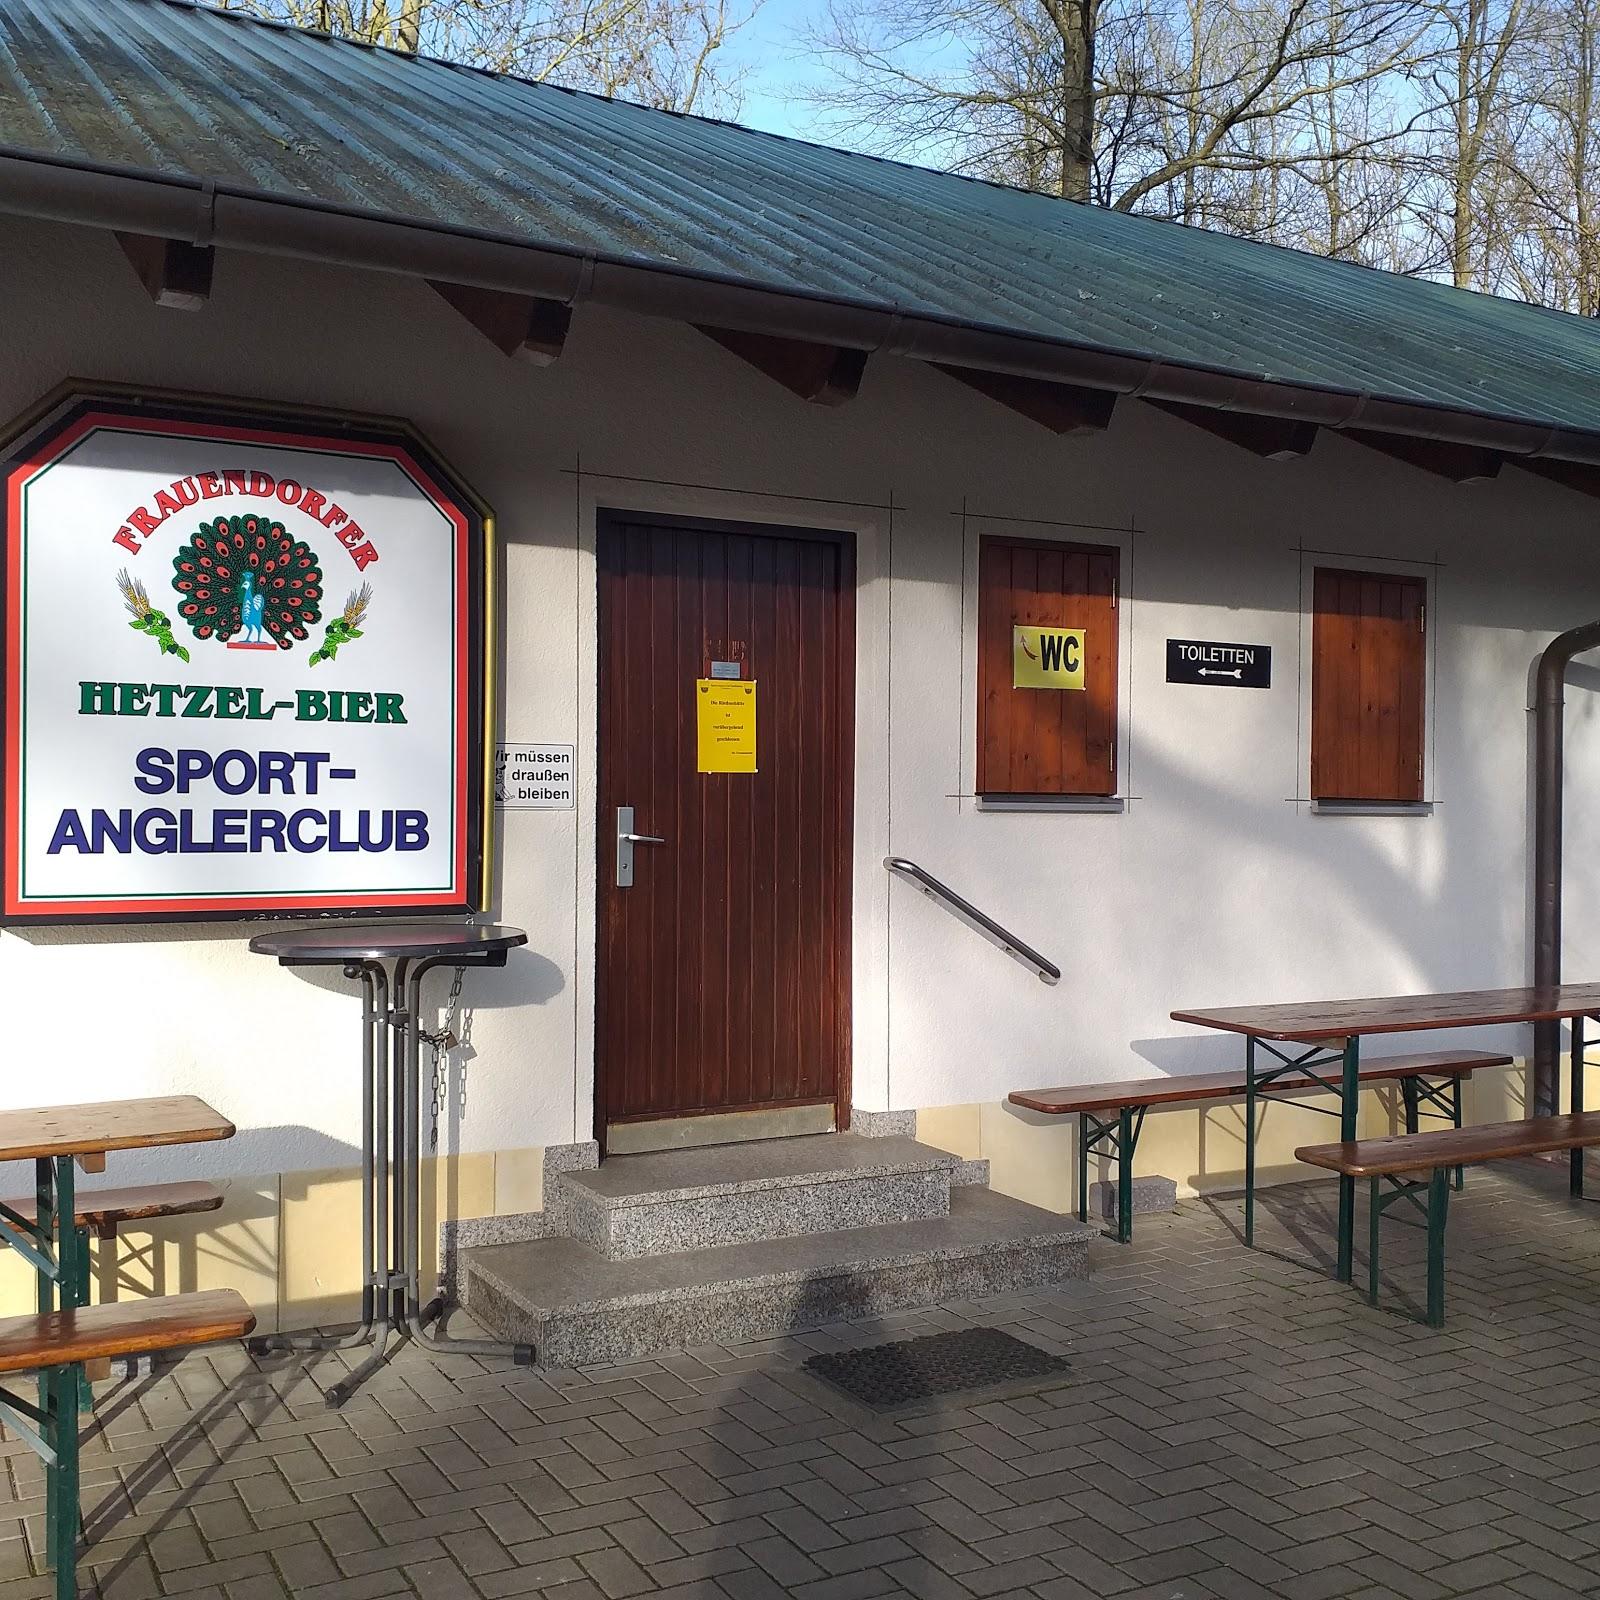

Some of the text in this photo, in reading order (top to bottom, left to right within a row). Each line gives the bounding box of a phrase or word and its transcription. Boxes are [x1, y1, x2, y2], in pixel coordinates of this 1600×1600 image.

[112, 469, 379, 571] FRAUENDORFER
[1040, 634, 1080, 673] WC
[1178, 645, 1255, 665] TOILETTEN
[79, 681, 408, 725] HETZEL-BIER
[134, 747, 356, 796] SPORT-
[511, 769, 569, 782] draußen
[515, 750, 570, 763] müssen
[518, 787, 570, 800] bleiben
[46, 807, 430, 855] ANGLERCLUB
